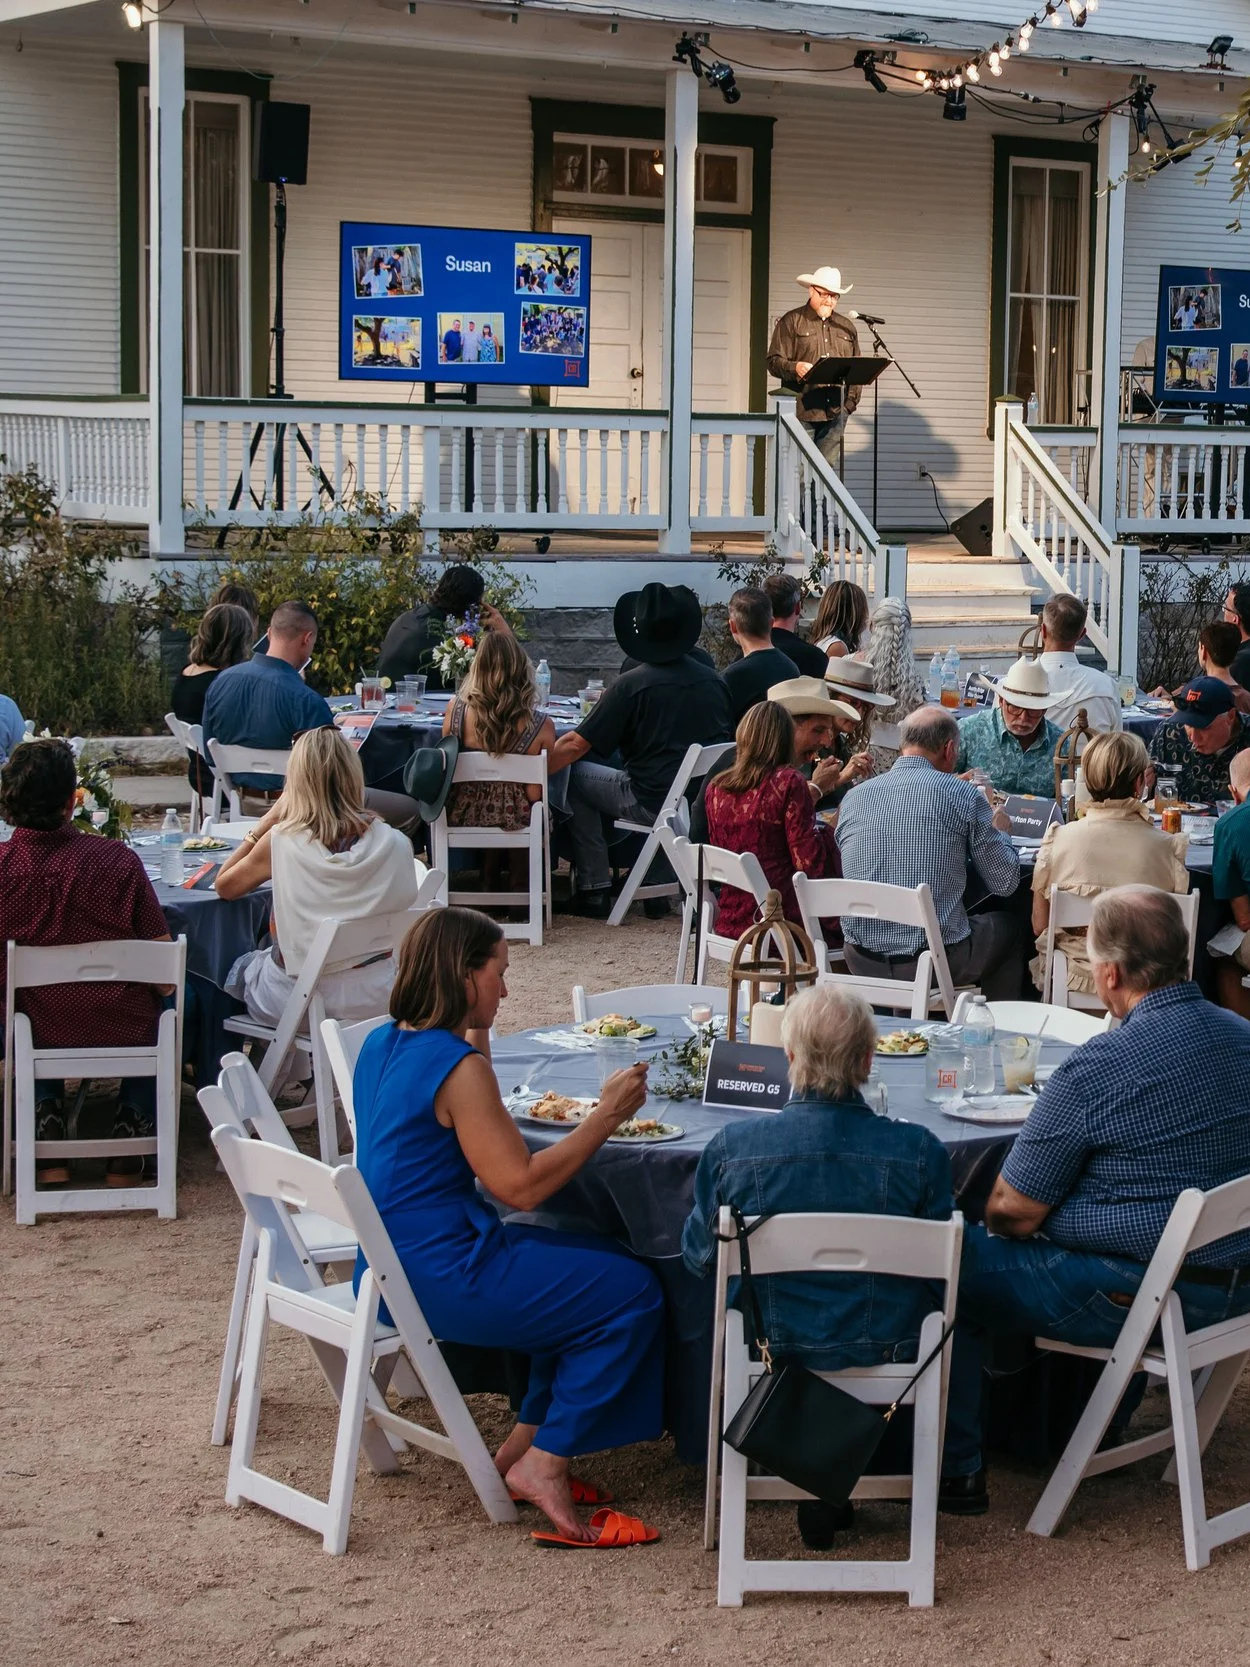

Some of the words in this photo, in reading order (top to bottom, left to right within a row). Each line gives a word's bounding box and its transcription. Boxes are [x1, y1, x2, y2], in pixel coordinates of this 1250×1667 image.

[445, 255, 492, 273] Susan
[1027, 817, 1043, 826] Party
[942, 1074, 953, 1084] CR
[717, 1078, 766, 1093] RESERVED
[767, 1084, 780, 1095] G5
